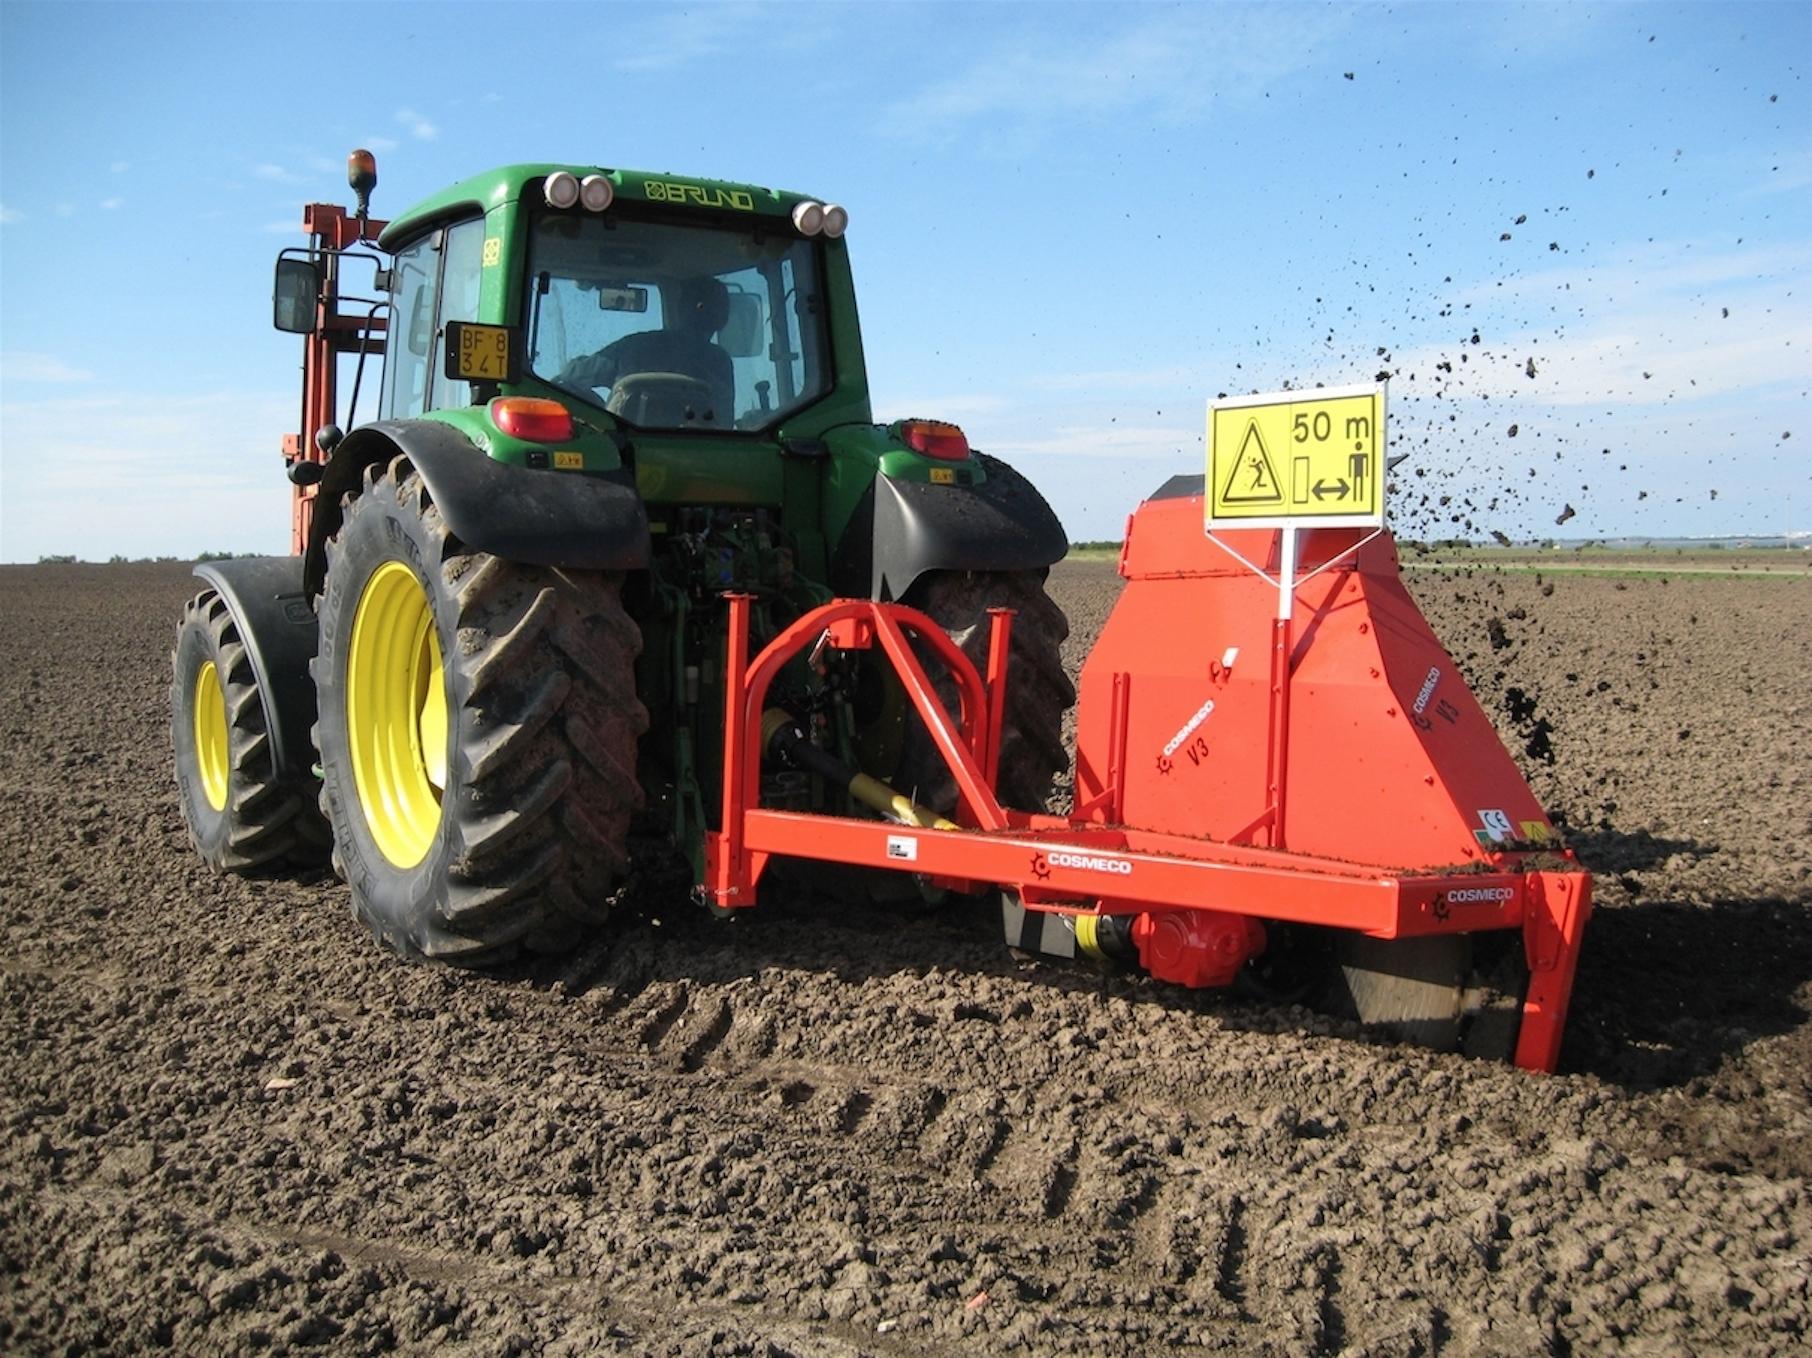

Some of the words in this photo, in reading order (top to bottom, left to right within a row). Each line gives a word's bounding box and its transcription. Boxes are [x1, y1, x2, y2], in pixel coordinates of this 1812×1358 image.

[666, 183, 754, 211] BRUNO
[462, 329, 484, 350] BF
[495, 333, 507, 352] 8
[1293, 411, 1332, 443] 50
[1345, 416, 1370, 440] m
[1412, 666, 1441, 714] COSMECO
[1186, 737, 1209, 767] V3
[1048, 854, 1132, 874] COSMECO
[1447, 887, 1515, 903] COSMECO
